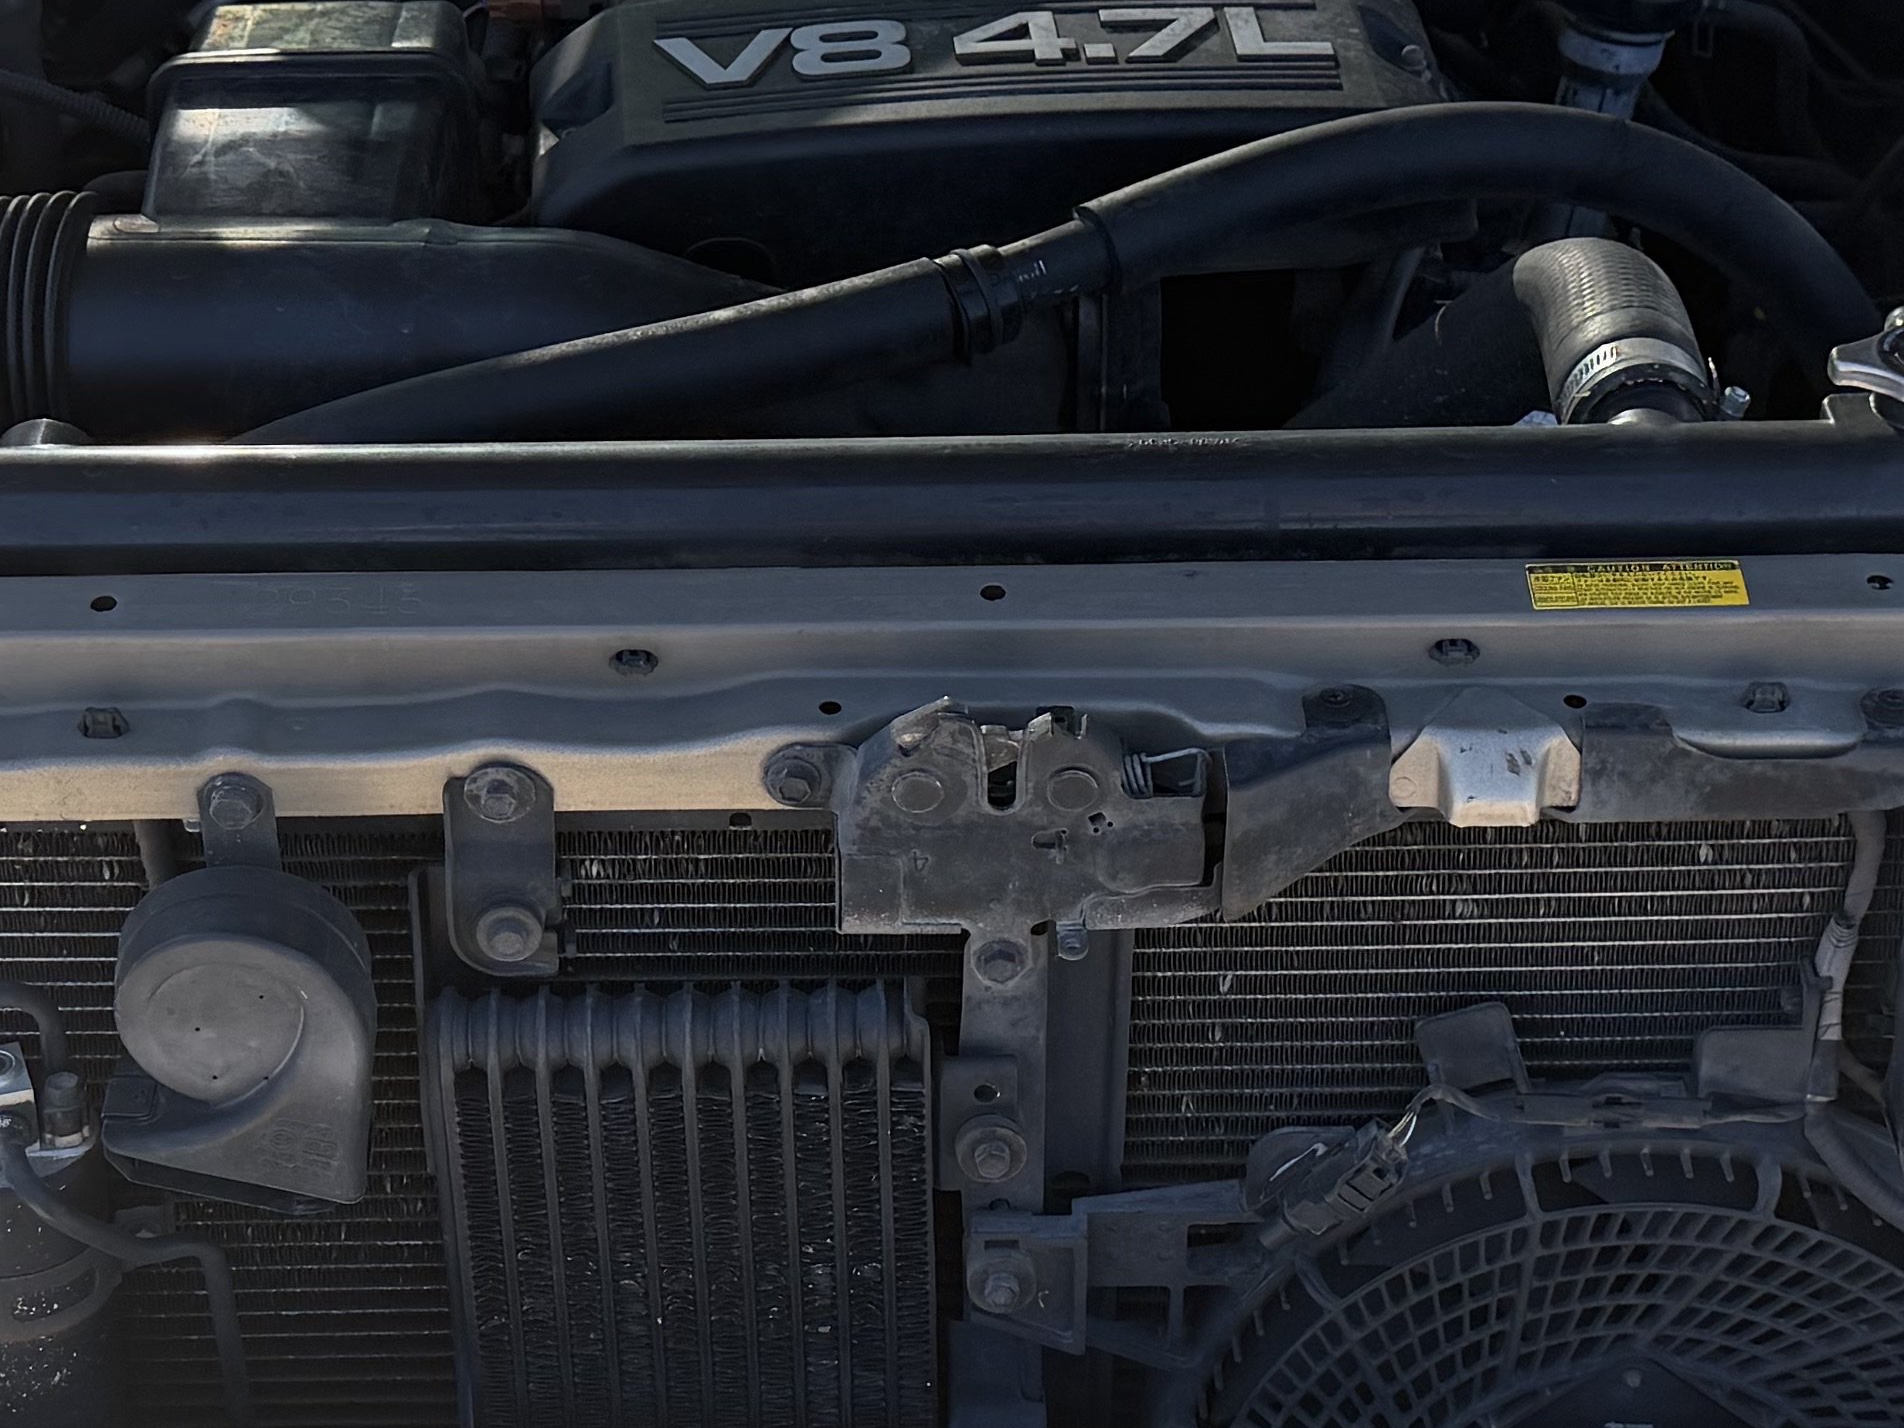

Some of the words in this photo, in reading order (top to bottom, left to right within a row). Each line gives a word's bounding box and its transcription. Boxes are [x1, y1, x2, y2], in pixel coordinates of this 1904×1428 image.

[654, 20, 911, 86] V8
[952, 6, 1336, 64] 4.7L
[1587, 564, 1650, 572] CAUTION
